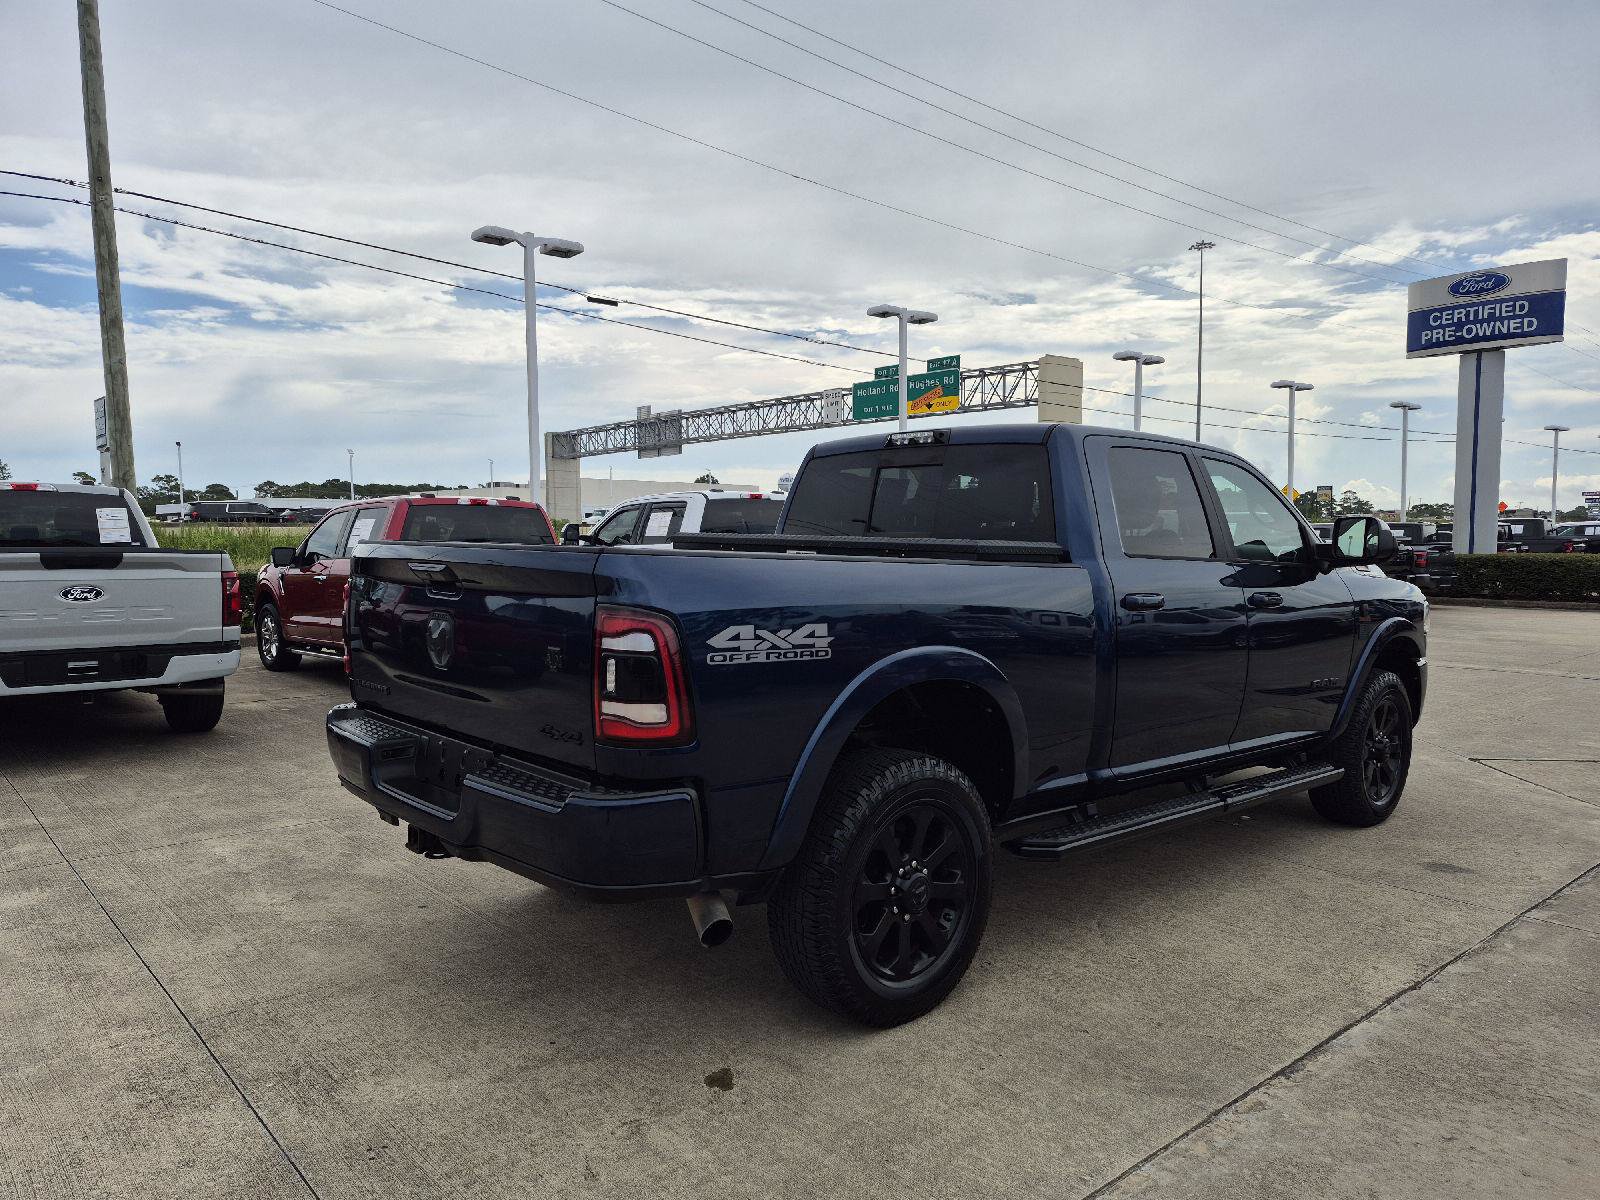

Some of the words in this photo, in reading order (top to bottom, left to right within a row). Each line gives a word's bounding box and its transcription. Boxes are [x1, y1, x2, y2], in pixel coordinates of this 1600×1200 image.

[1459, 273, 1495, 292] Ford
[1429, 300, 1529, 326] CERTIFIED
[1421, 317, 1538, 344] PRE-OWNED
[909, 379, 940, 389] Hughes
[943, 375, 954, 385] Rd
[857, 385, 886, 397] Holland
[889, 383, 899, 393] Rd
[935, 400, 953, 408] ONLY
[709, 651, 761, 663] OFF
[765, 649, 830, 661] ROAD
